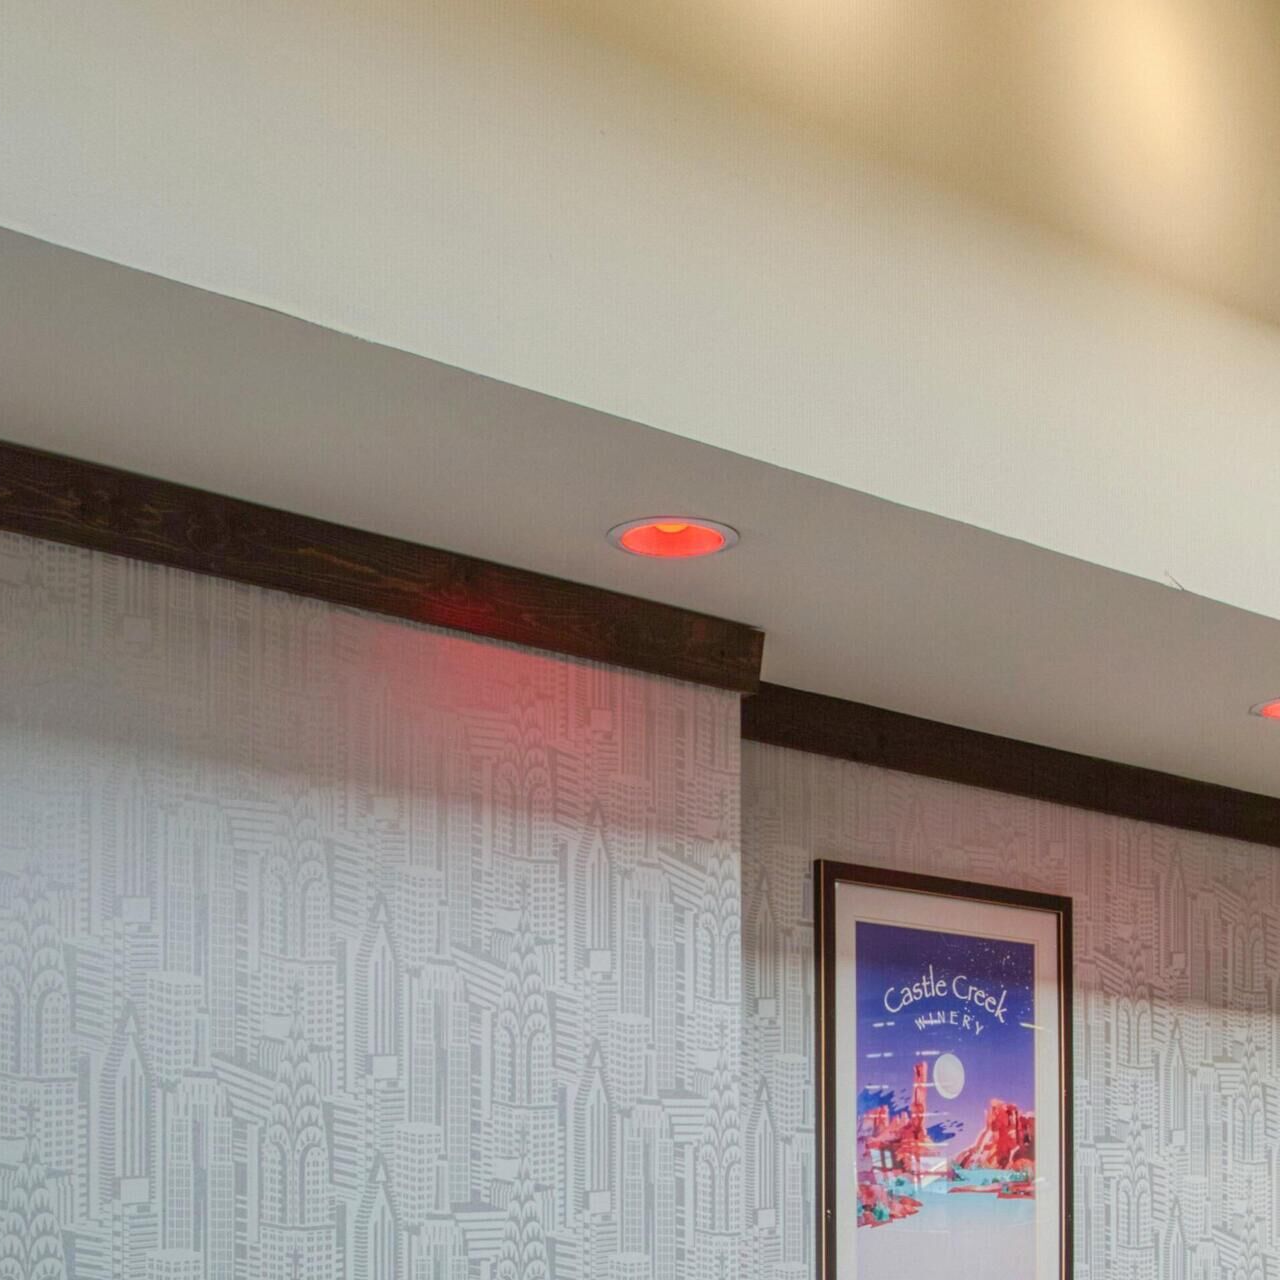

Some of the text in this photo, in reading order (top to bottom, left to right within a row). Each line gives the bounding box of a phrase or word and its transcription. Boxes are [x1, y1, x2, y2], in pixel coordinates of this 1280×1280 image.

[884, 964, 1007, 1023] Castle Creek
[914, 1010, 984, 1035] WINERY
